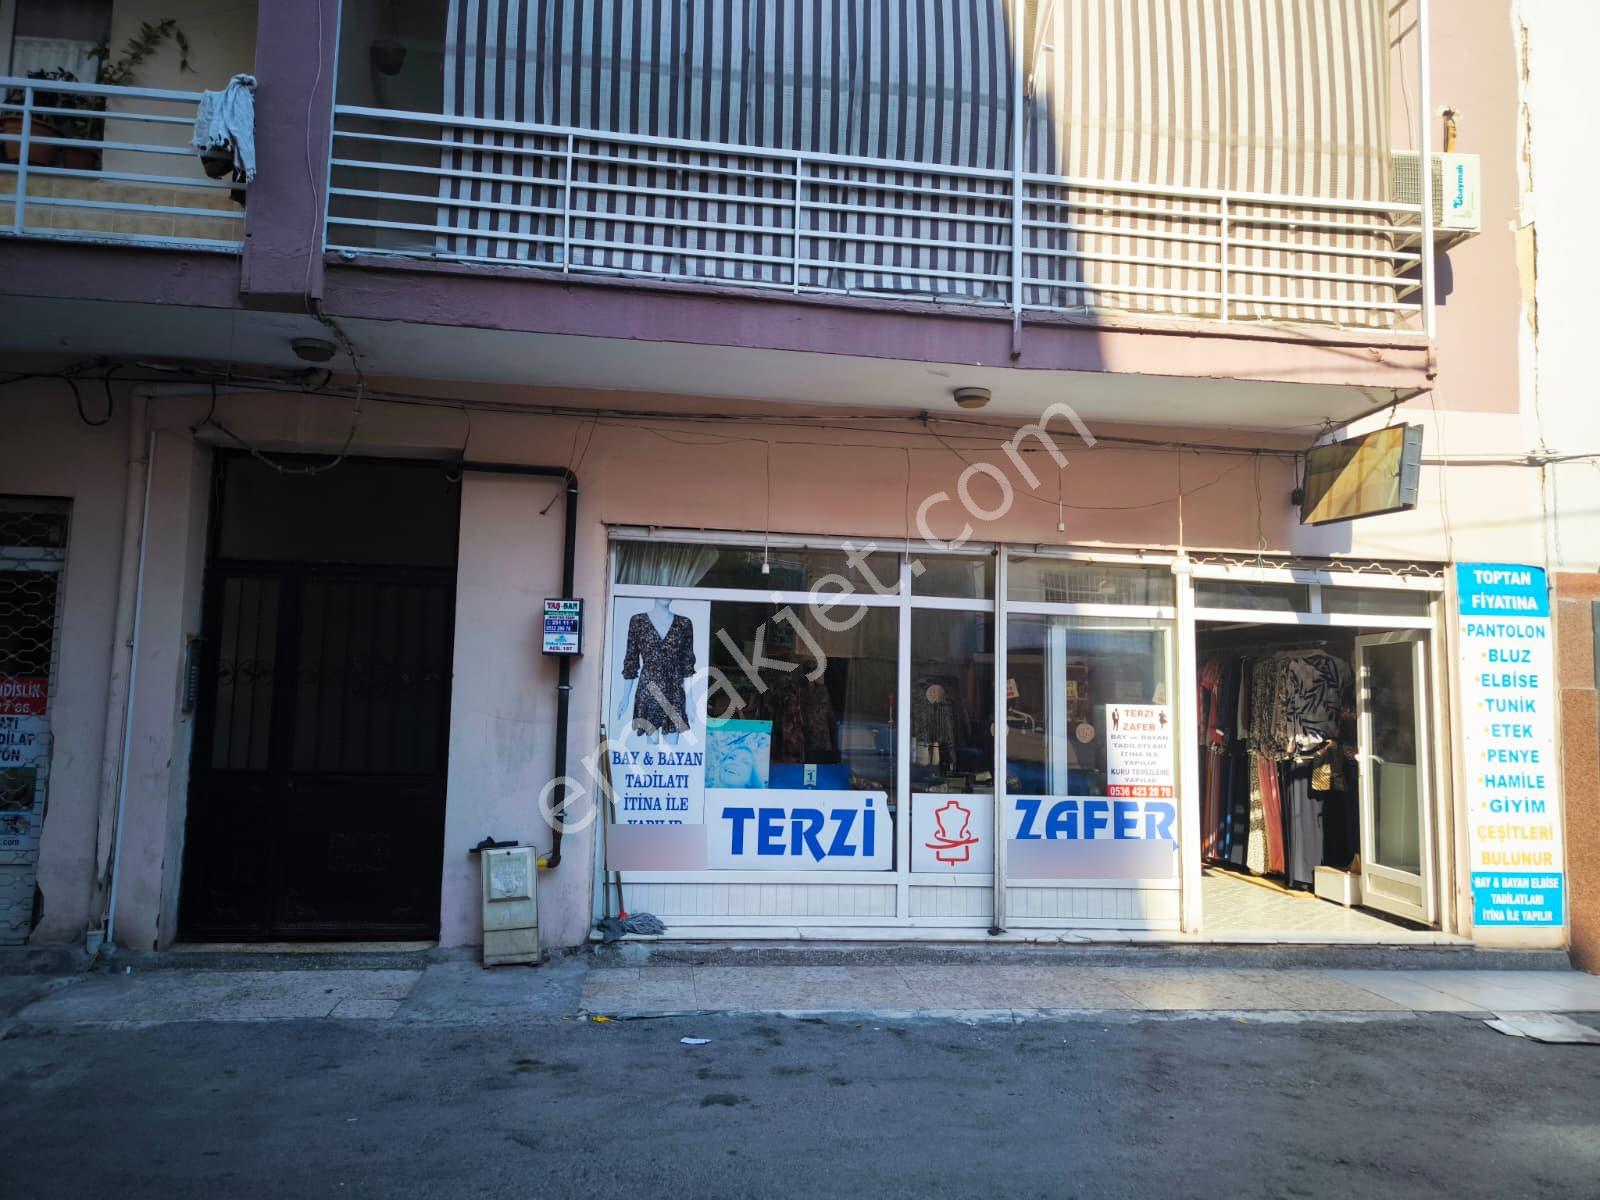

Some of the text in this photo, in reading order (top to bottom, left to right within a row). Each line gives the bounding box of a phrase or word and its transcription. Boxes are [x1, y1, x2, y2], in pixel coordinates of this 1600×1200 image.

[1473, 569, 1531, 585] TOPTAN
[1471, 592, 1539, 610] FİYATINA
[1467, 623, 1545, 638] PANTOLON
[1488, 649, 1531, 663] BLUZ
[1481, 671, 1539, 688] ELBİSE
[1485, 696, 1536, 713] TUNİK
[1122, 723, 1156, 732] ZAFER
[1491, 724, 1533, 738] ETEK
[612, 751, 703, 766] BAY & BAYAN
[1487, 749, 1540, 763] PENYE
[625, 771, 689, 788] TADİLATI
[1110, 768, 1130, 776] KURU
[1485, 772, 1545, 789] HAMİLE
[1110, 786, 1130, 797] 0536
[623, 793, 689, 811] İTİNA İLE
[1489, 796, 1545, 813] GİYİM
[722, 798, 1178, 862] TERZİ ZAFER
[1481, 851, 1552, 865] BULUNUR
[1474, 876, 1490, 888] BAY
[1502, 877, 1529, 889] BAYAN
[1531, 876, 1559, 889] ELBİSE
[1491, 892, 1544, 905] TADİLATLARI
[1507, 908, 1520, 921] İLE
[1522, 910, 1552, 921] YAPILIR
